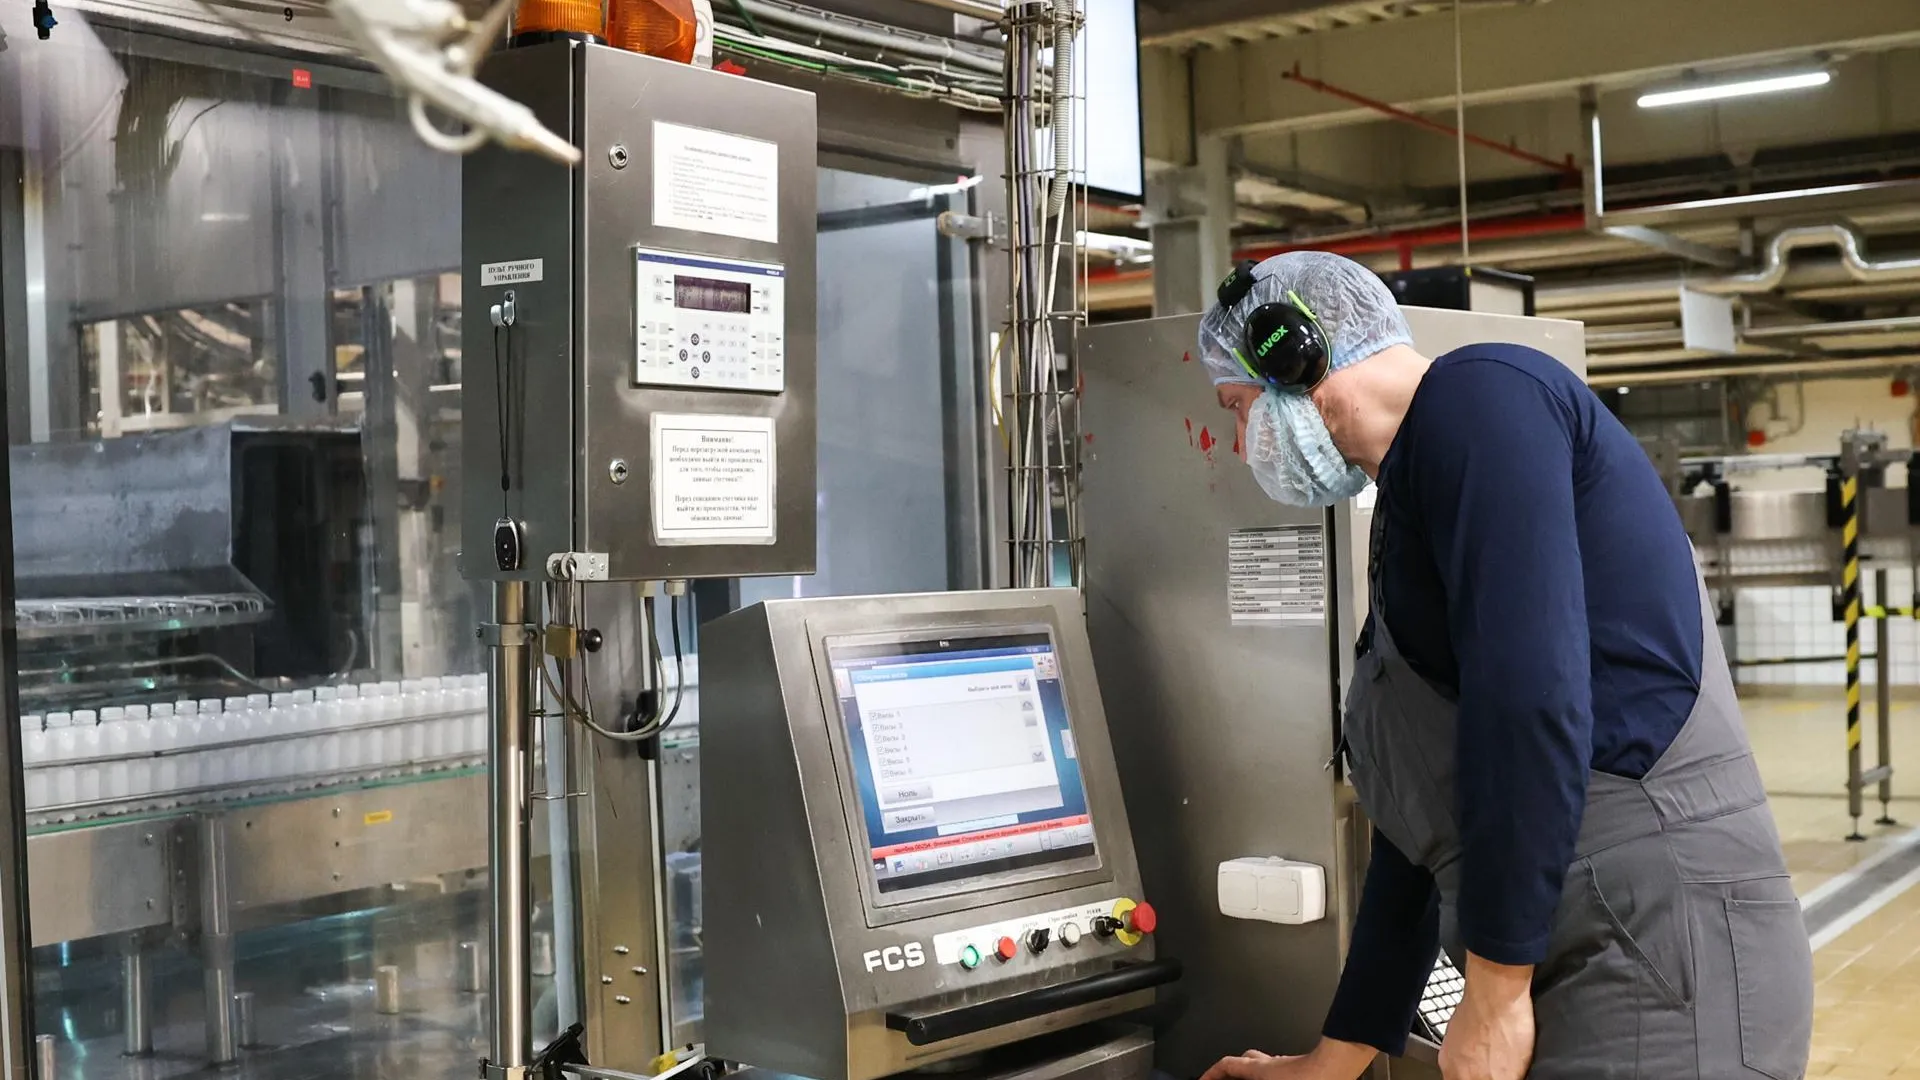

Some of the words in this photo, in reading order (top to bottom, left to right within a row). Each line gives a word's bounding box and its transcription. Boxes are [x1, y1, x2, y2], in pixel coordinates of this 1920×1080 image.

[284, 7, 293, 22] 9
[507, 263, 535, 272] РУЧНОГО
[494, 272, 531, 281] УПРАВЛЕНИЯ
[1257, 325, 1289, 356] uvex
[895, 814, 926, 824] Закрыть
[863, 942, 926, 973] FCS
